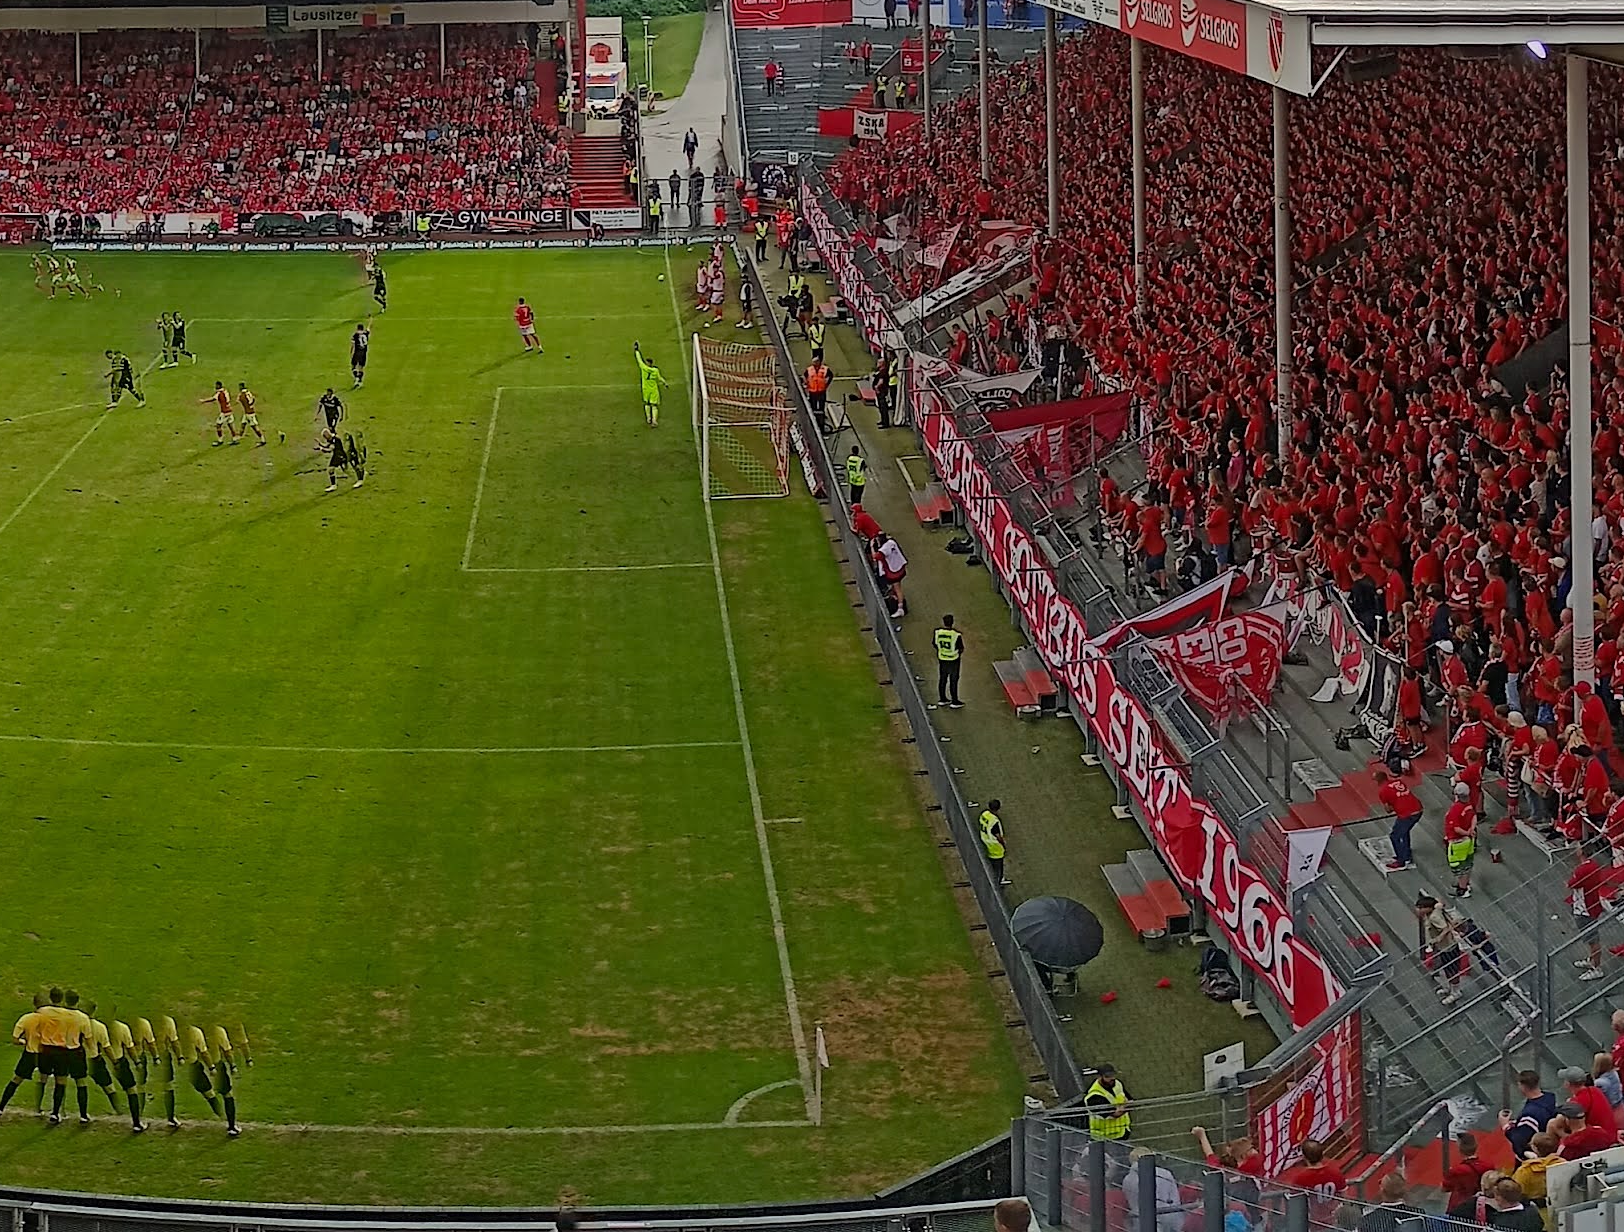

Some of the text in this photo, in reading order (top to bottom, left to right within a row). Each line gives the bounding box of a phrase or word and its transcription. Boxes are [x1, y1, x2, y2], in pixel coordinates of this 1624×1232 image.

[292, 8, 358, 21] Lausitzer
[1200, 13, 1240, 50] SELGROS
[857, 115, 885, 128] ZSKA
[457, 210, 494, 224] GYM
[1196, 809, 1296, 1007] 1966
